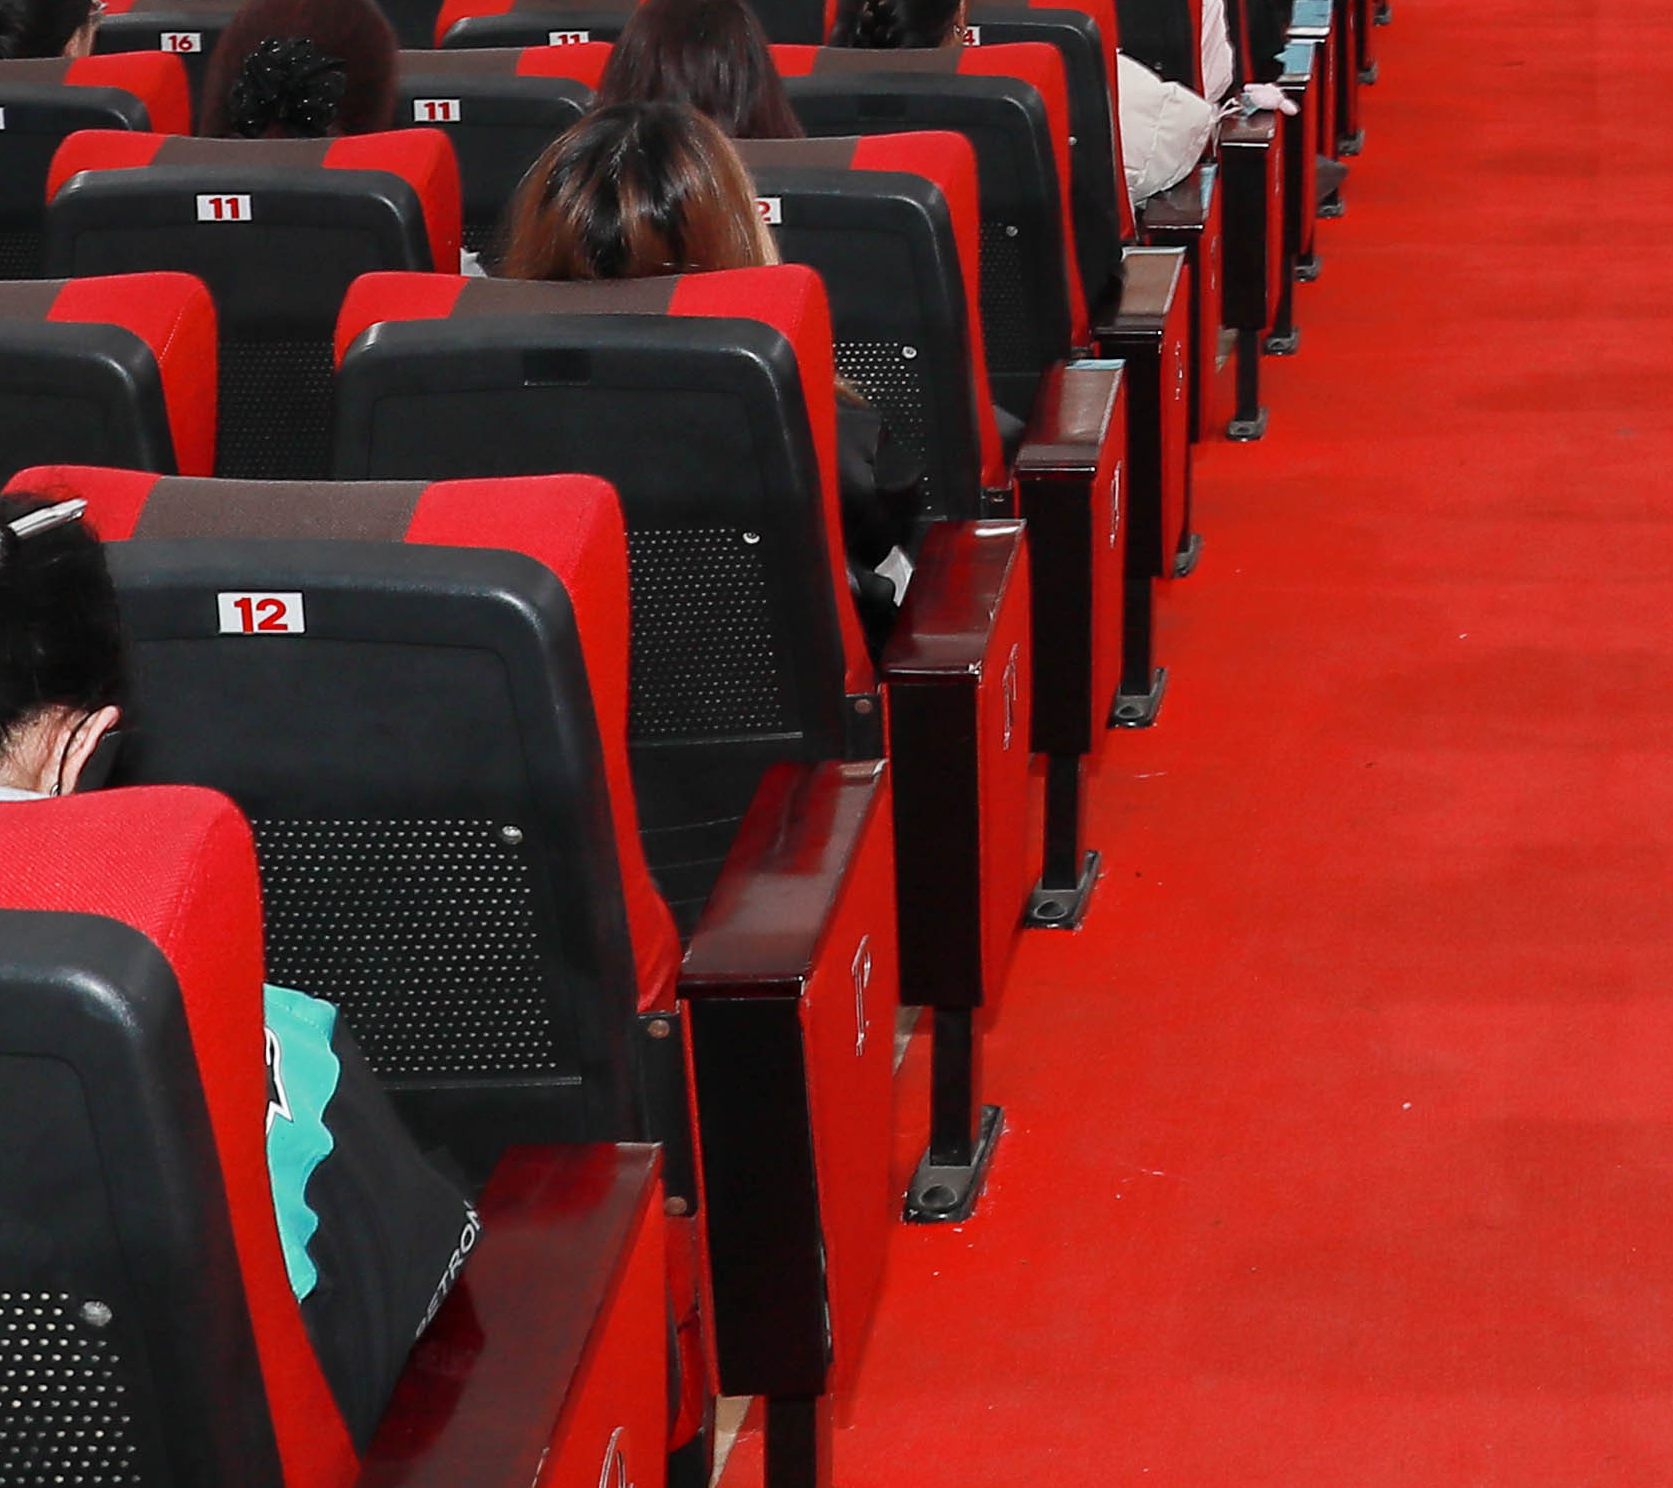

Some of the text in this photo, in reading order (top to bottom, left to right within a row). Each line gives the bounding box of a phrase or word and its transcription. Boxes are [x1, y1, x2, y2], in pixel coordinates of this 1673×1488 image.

[168, 35, 193, 51] 16
[424, 101, 451, 121] 11
[209, 197, 240, 220] 11
[234, 597, 288, 633] 12
